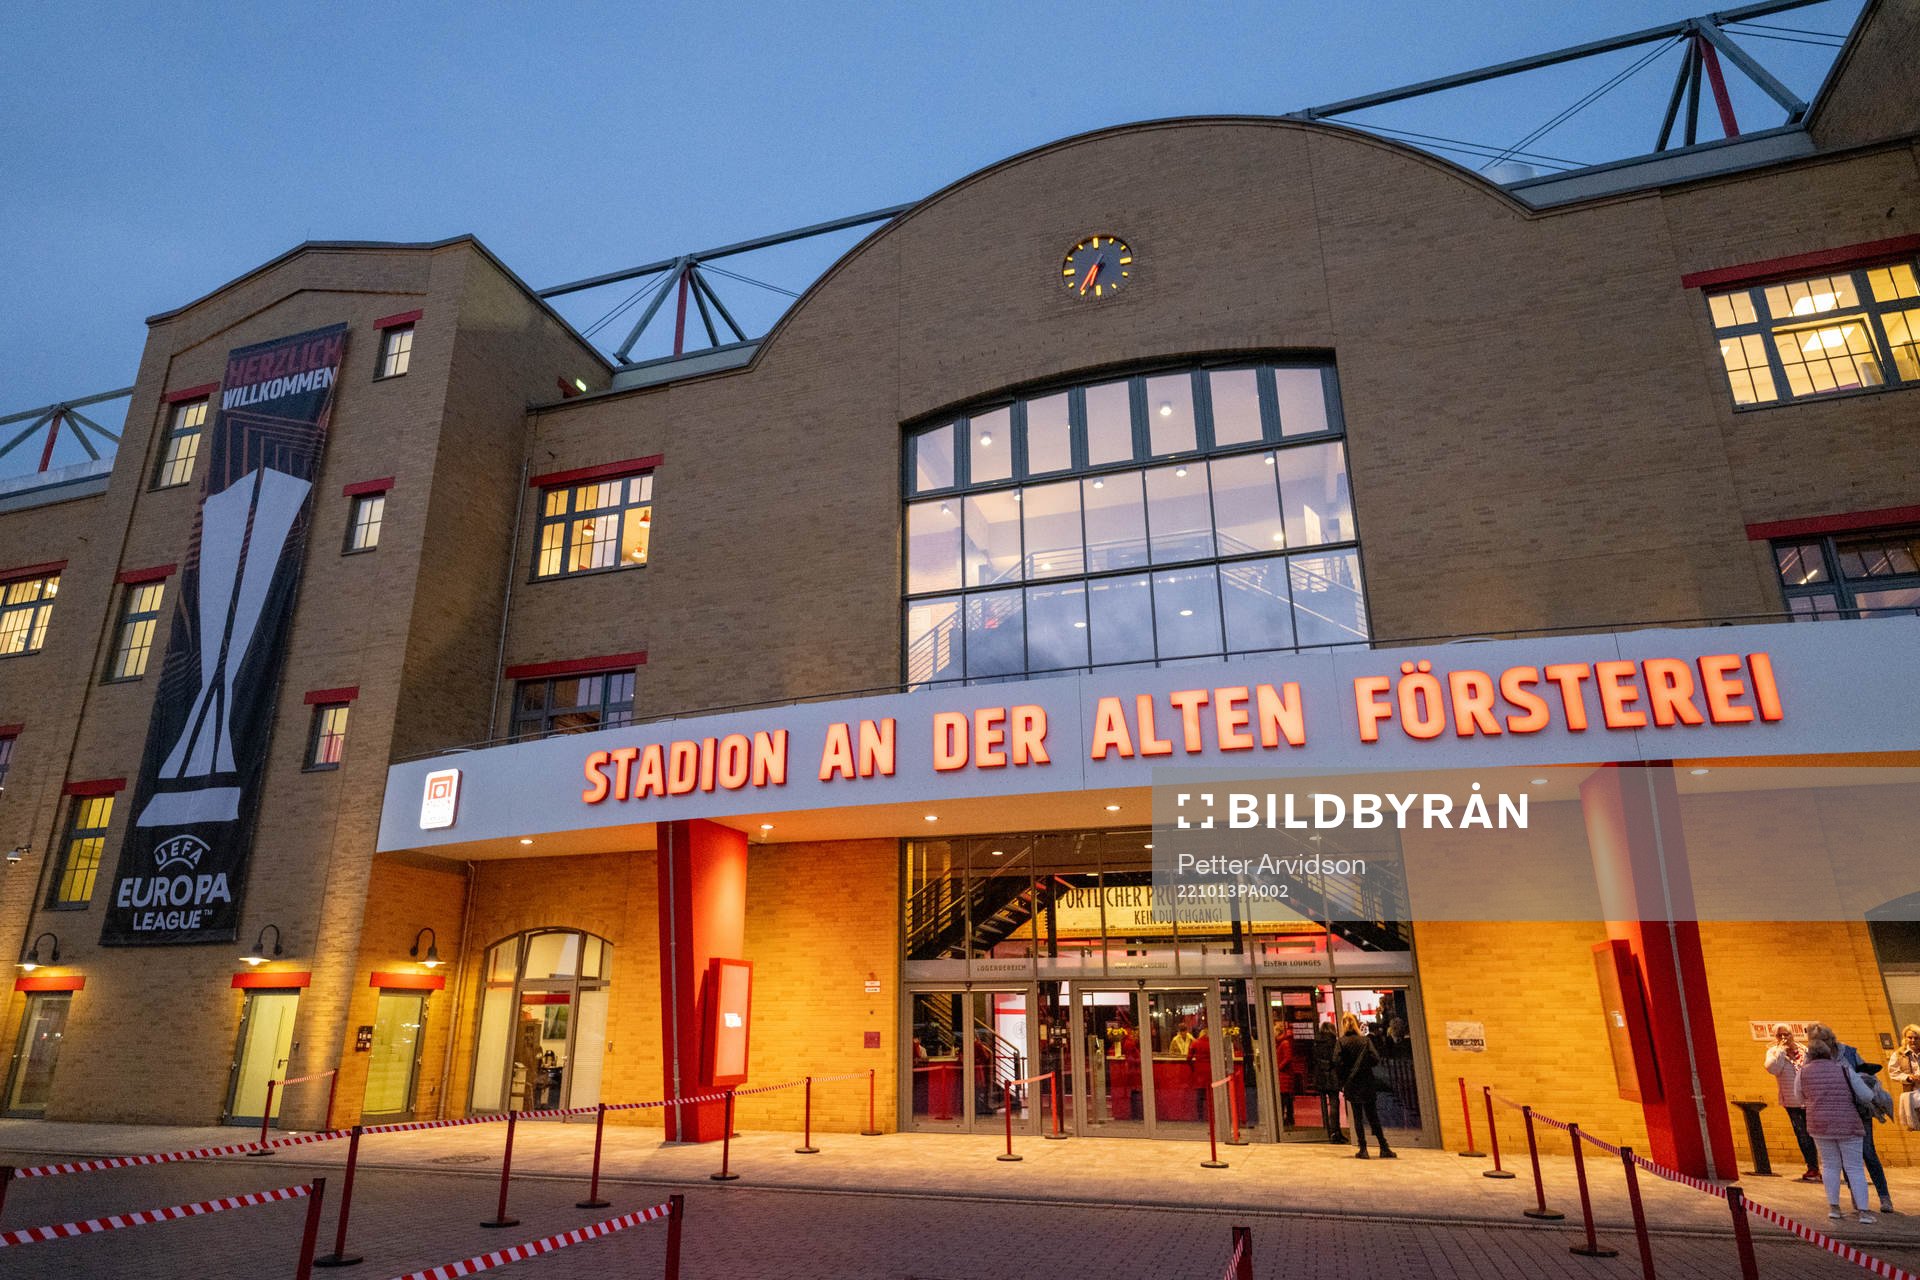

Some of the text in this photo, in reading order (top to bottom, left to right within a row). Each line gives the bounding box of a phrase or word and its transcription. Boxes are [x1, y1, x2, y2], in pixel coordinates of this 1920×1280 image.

[225, 332, 341, 387] HERZLICH
[222, 366, 338, 411] WILLKOMMEN
[582, 652, 1784, 804] STADION AN DER ALTEN FÖRSTEREI
[154, 841, 203, 866] UEFA
[117, 872, 231, 908] EUROPA
[1134, 908, 1223, 925] KEIN DUCHGANG!
